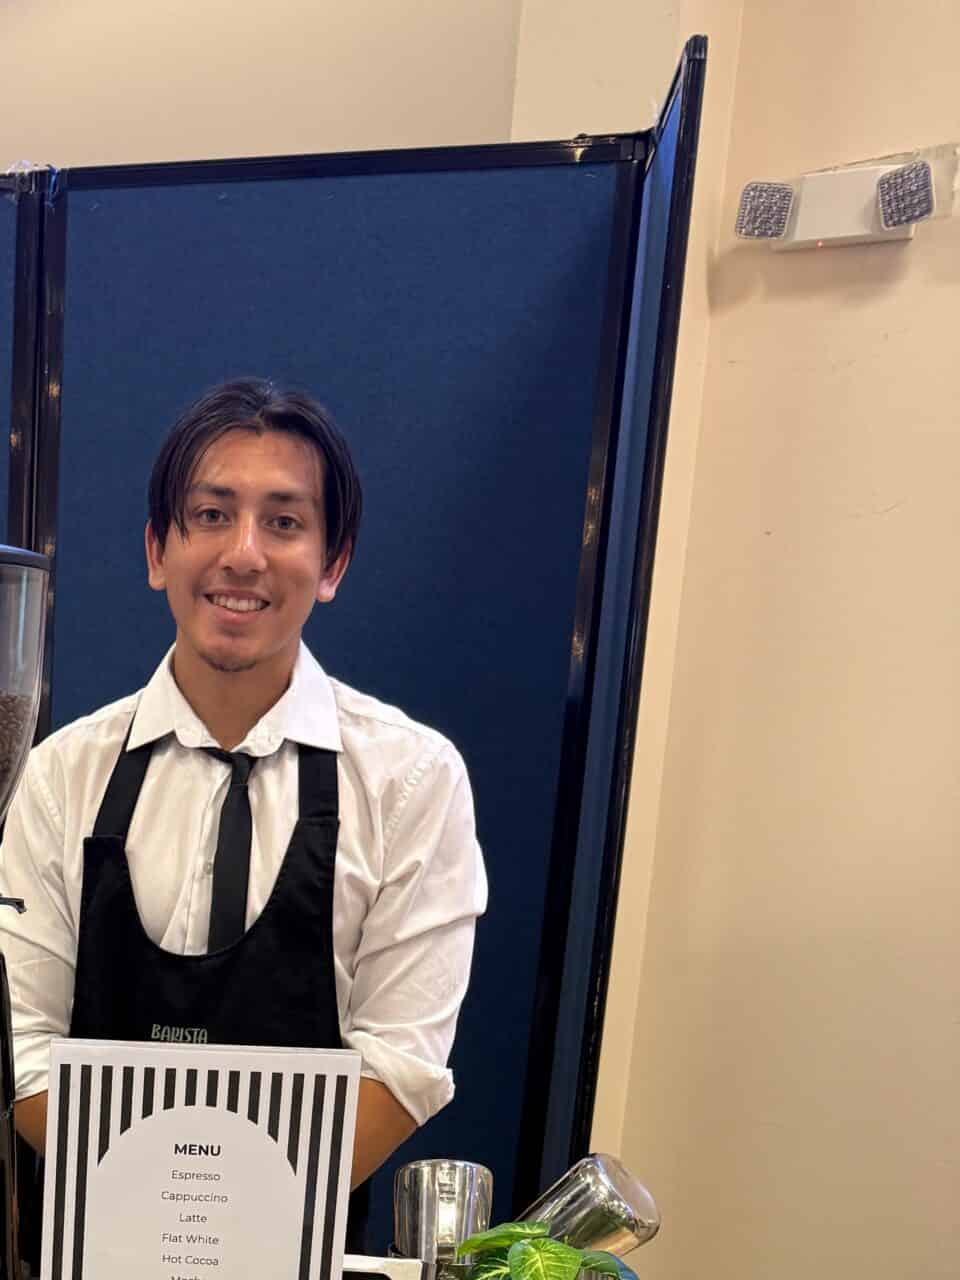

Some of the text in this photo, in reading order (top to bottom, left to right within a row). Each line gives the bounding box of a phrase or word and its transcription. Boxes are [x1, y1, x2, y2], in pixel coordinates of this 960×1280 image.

[151, 1023, 208, 1044] BARISTA
[174, 1143, 221, 1157] MENU
[171, 1169, 221, 1183] Espresso
[161, 1191, 229, 1204] Cappuccino
[179, 1213, 208, 1224] Latte
[161, 1233, 219, 1245] Flat White
[161, 1254, 219, 1267] Hot Cocoa
